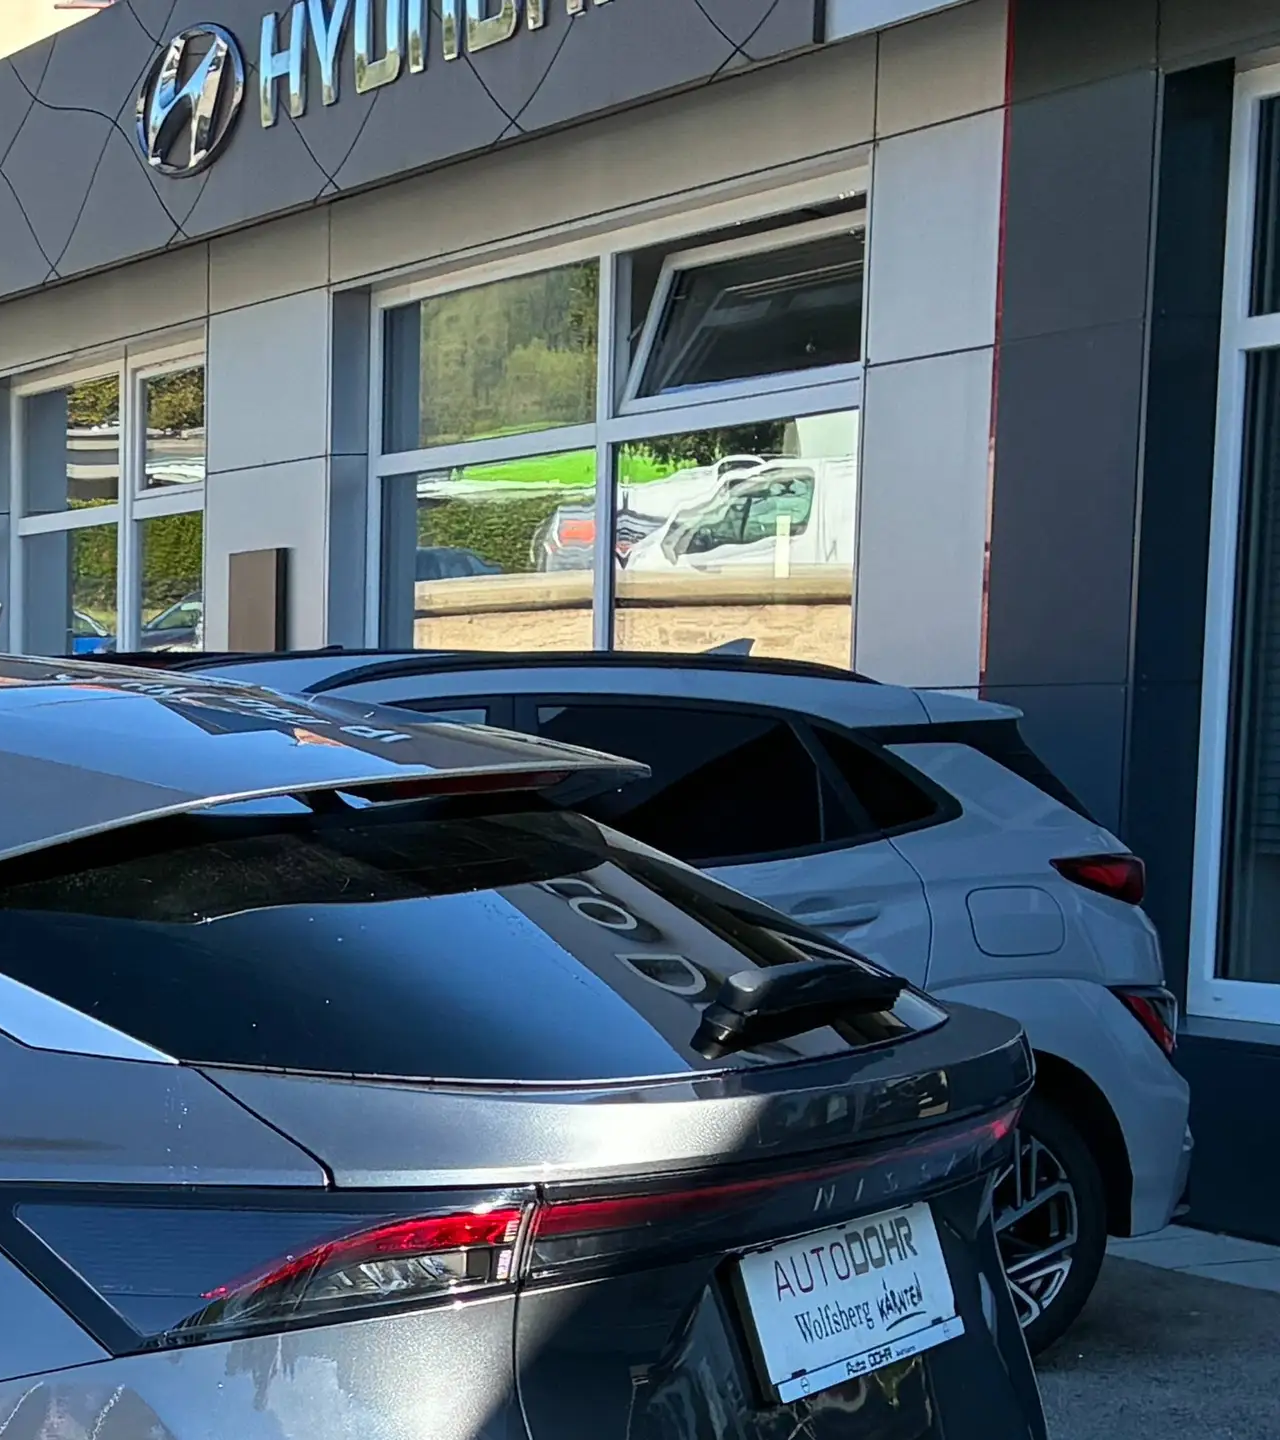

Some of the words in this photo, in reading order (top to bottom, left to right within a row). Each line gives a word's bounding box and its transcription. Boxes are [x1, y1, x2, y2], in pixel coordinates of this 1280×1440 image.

[259, 0, 617, 128] HYUN
[812, 1152, 965, 1212] NISS
[795, 1301, 873, 1344] Wolfsberg
